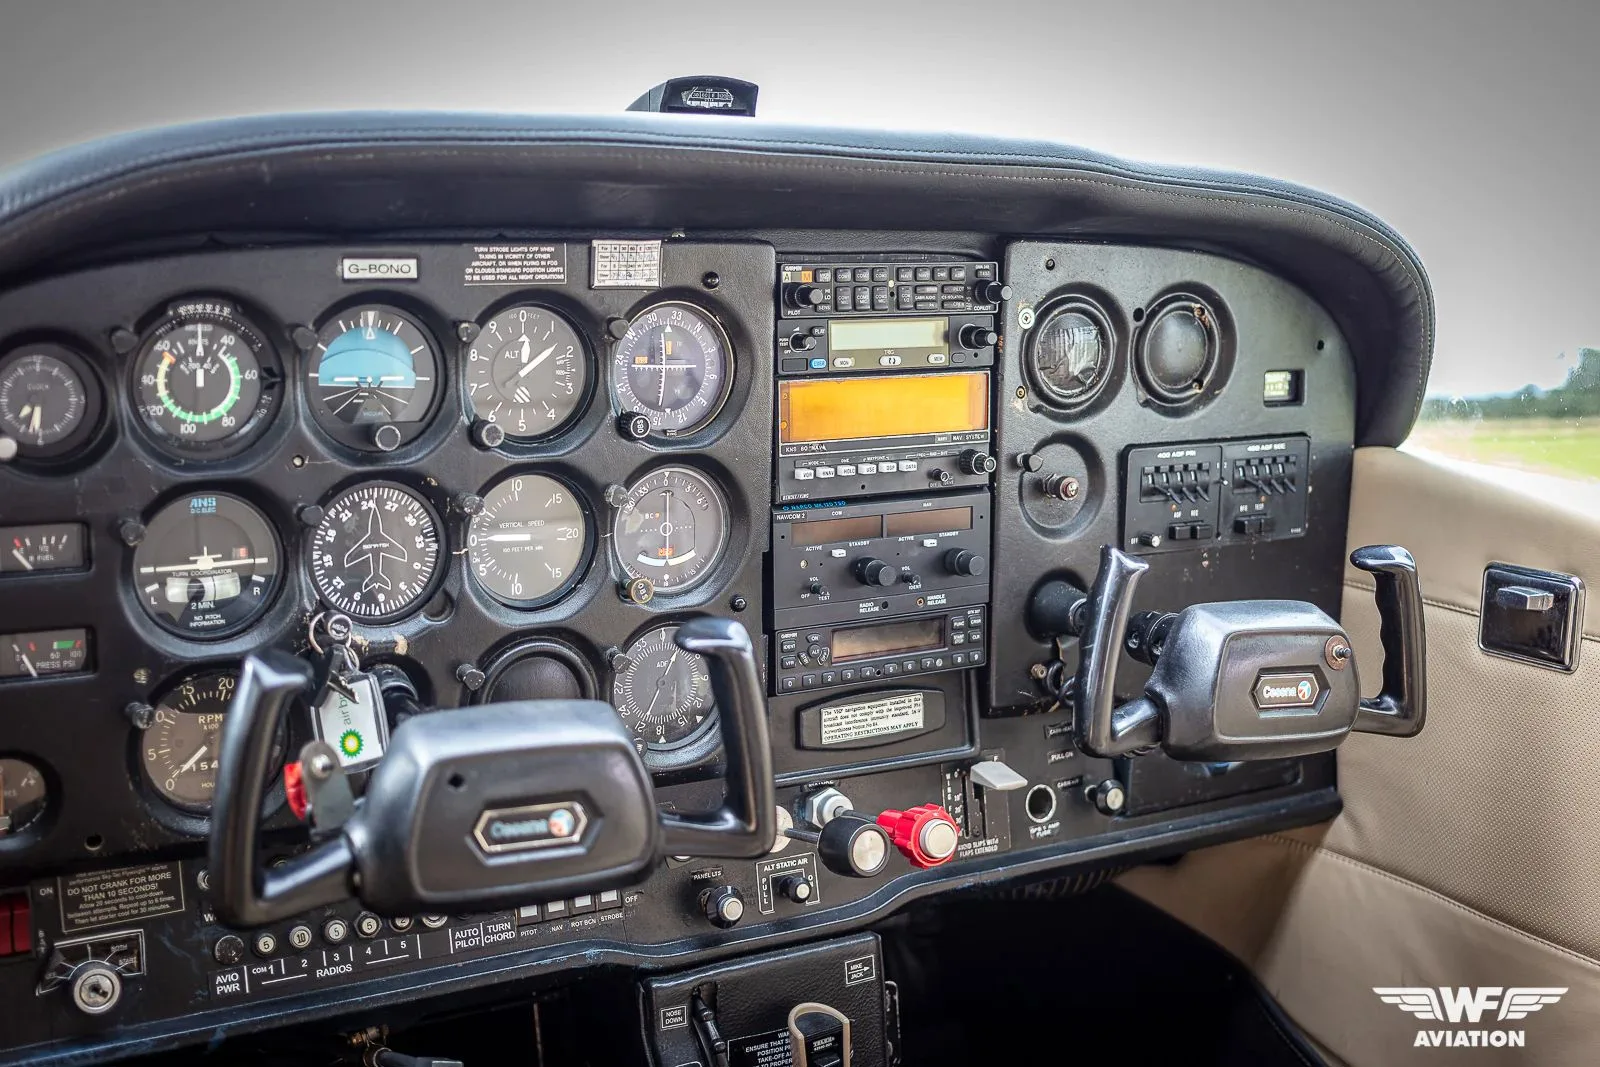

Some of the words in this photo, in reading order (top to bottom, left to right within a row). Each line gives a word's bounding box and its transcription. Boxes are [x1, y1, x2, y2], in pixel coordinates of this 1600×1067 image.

[348, 264, 411, 274] G-BONO
[647, 313, 658, 323] 30
[672, 310, 682, 320] 33
[220, 335, 234, 346] 40
[470, 350, 478, 360] 8
[504, 350, 518, 358] ALT
[566, 346, 574, 358] 2
[616, 354, 624, 365] 24
[244, 370, 257, 380] 60
[470, 384, 478, 395] 7
[566, 383, 574, 394] 3
[547, 410, 556, 420] 4
[222, 416, 235, 427] 80
[518, 420, 526, 431] 5
[180, 424, 196, 434] 100
[512, 480, 522, 492] 10
[552, 494, 562, 504] 15
[361, 500, 375, 510] 24
[385, 501, 399, 512] 27
[339, 511, 352, 522] 21
[404, 514, 417, 526] 30
[325, 530, 336, 542] 18
[566, 528, 578, 538] 20
[415, 535, 424, 548] 33
[470, 535, 478, 546] 0
[479, 564, 487, 575] 5
[552, 567, 562, 578] 15
[254, 586, 260, 596] R
[512, 584, 522, 594] 10
[151, 597, 157, 605] L
[189, 620, 226, 628] INFORMATION
[636, 640, 647, 652] 33
[218, 678, 234, 689] 20
[614, 682, 624, 694] 27
[182, 686, 195, 695] 15
[1263, 686, 1296, 698] Cessna
[693, 697, 703, 708] 12
[619, 705, 630, 718] 24
[198, 714, 223, 724] RPM
[678, 716, 688, 727] 15
[635, 721, 646, 733] 21
[656, 725, 664, 735] 18
[148, 750, 156, 760] 5
[166, 780, 174, 790] 0
[776, 860, 796, 870] STATIC
[798, 858, 808, 866] AIR
[694, 872, 710, 880] PANEL
[82, 884, 98, 892] NOT
[100, 880, 128, 890] CRANK
[130, 876, 146, 884] FOR
[148, 872, 172, 882] MORE
[40, 888, 52, 896] ON
[84, 892, 105, 902] THAN
[118, 883, 158, 896] SECONDS!
[626, 895, 638, 904] OFF
[601, 912, 624, 922] STROBE
[366, 922, 373, 930] 5
[487, 922, 511, 932] TURN
[297, 932, 306, 943] 10
[334, 928, 340, 937] 5
[455, 928, 478, 939] AUTO
[484, 931, 516, 943] CHORD
[264, 940, 270, 950] 5
[400, 940, 406, 948] 5
[456, 938, 480, 949] PILOT
[366, 946, 372, 955] 4
[334, 953, 340, 962] 3
[302, 959, 308, 968] 2
[850, 962, 863, 970] MIKE
[316, 964, 352, 978] RADIOS
[216, 974, 238, 984] AVIO
[217, 984, 240, 995] PWR
[666, 1016, 682, 1024] DOWN
[746, 1042, 769, 1053] ENSURE
[770, 1040, 784, 1048] THAT
[757, 1047, 784, 1057] POSITION
[758, 1052, 786, 1064] TAKE-OFF
